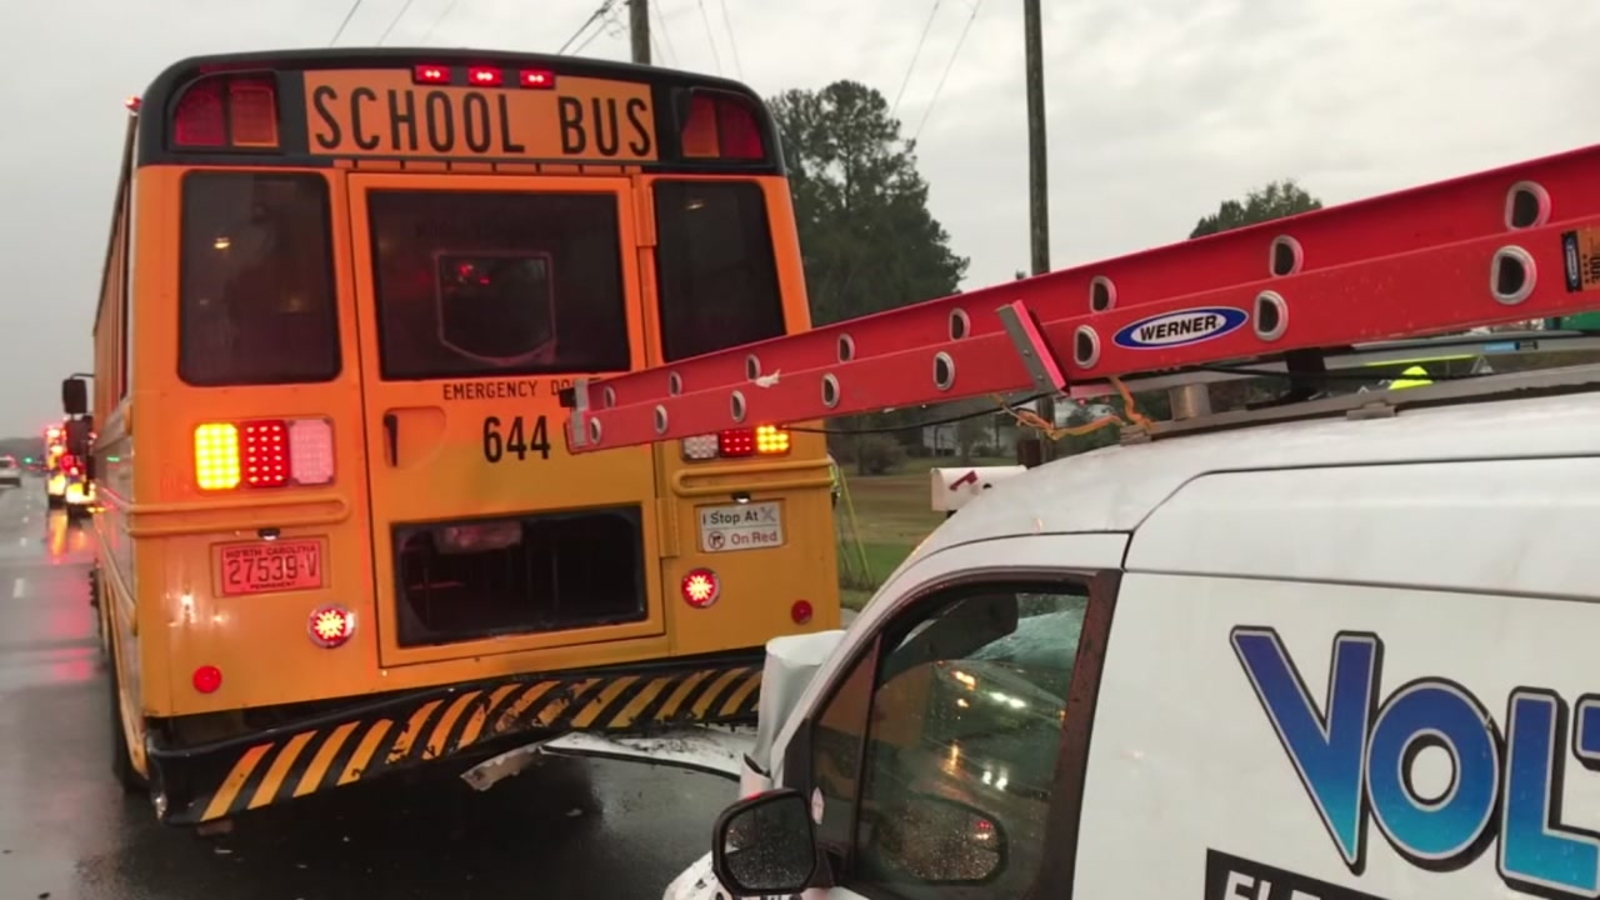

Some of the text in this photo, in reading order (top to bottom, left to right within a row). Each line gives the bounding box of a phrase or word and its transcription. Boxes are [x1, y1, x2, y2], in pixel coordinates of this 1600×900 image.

[313, 84, 651, 157] SCHOOL BUS
[1140, 315, 1218, 341] WERNER
[443, 380, 538, 400] EMERGENCY
[483, 415, 551, 463] 644
[710, 510, 740, 526] Stop
[744, 510, 759, 522] At
[731, 530, 778, 546] On Red
[227, 552, 317, 585] 27539-V
[1230, 624, 1600, 900] VOL
